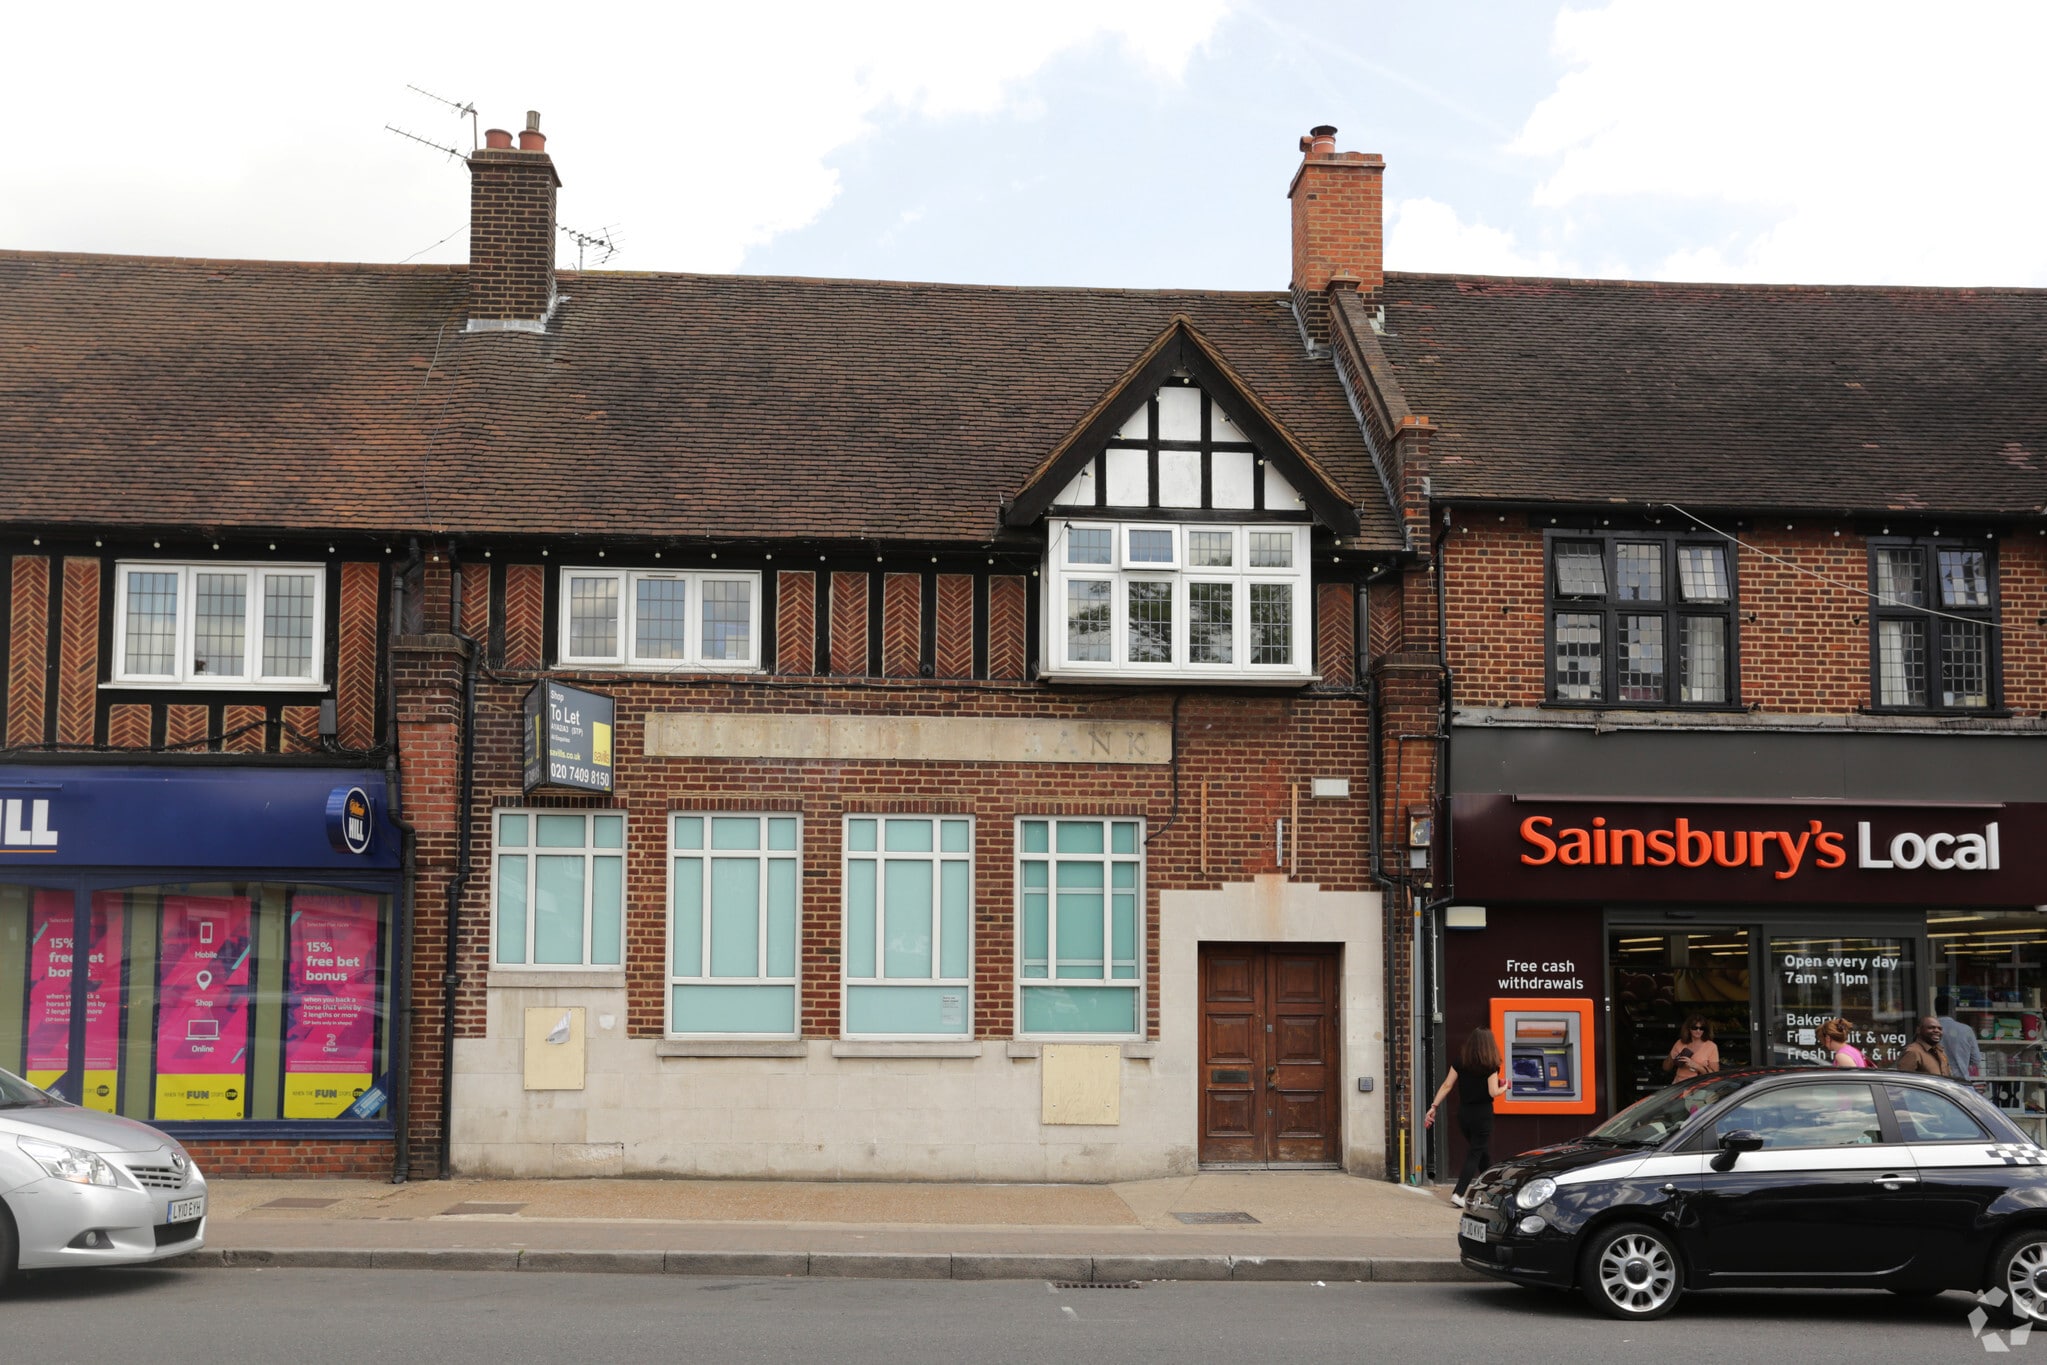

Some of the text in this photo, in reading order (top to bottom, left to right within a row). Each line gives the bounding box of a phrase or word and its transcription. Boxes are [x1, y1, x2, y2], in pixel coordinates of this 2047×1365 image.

[551, 690, 564, 703] Shop
[550, 703, 580, 725] To Let
[551, 763, 609, 787] 020 7409 8150
[0, 799, 58, 845] LL
[349, 817, 364, 841] HILL
[1519, 815, 2000, 880] Sainsbury's Local
[307, 942, 332, 952] 15%
[89, 953, 104, 963] et
[195, 951, 218, 959] Mobile
[307, 956, 360, 967] free bet
[1506, 960, 1575, 972] Free cash
[1785, 955, 1898, 970] Open every day
[306, 970, 347, 981] bonus
[1785, 972, 1817, 984] 7am
[1833, 972, 1869, 987] 11pm
[1498, 977, 1584, 989] withdrawals
[195, 999, 213, 1007] Shop
[326, 1034, 336, 1046] 2
[1866, 1031, 1876, 1043] &
[1881, 1034, 1906, 1046] veg
[192, 1045, 214, 1053] Online
[1787, 1048, 1826, 1060] Fresh
[1872, 1048, 1882, 1060] &
[186, 1090, 209, 1099] FUN
[315, 1089, 337, 1098] FUN
